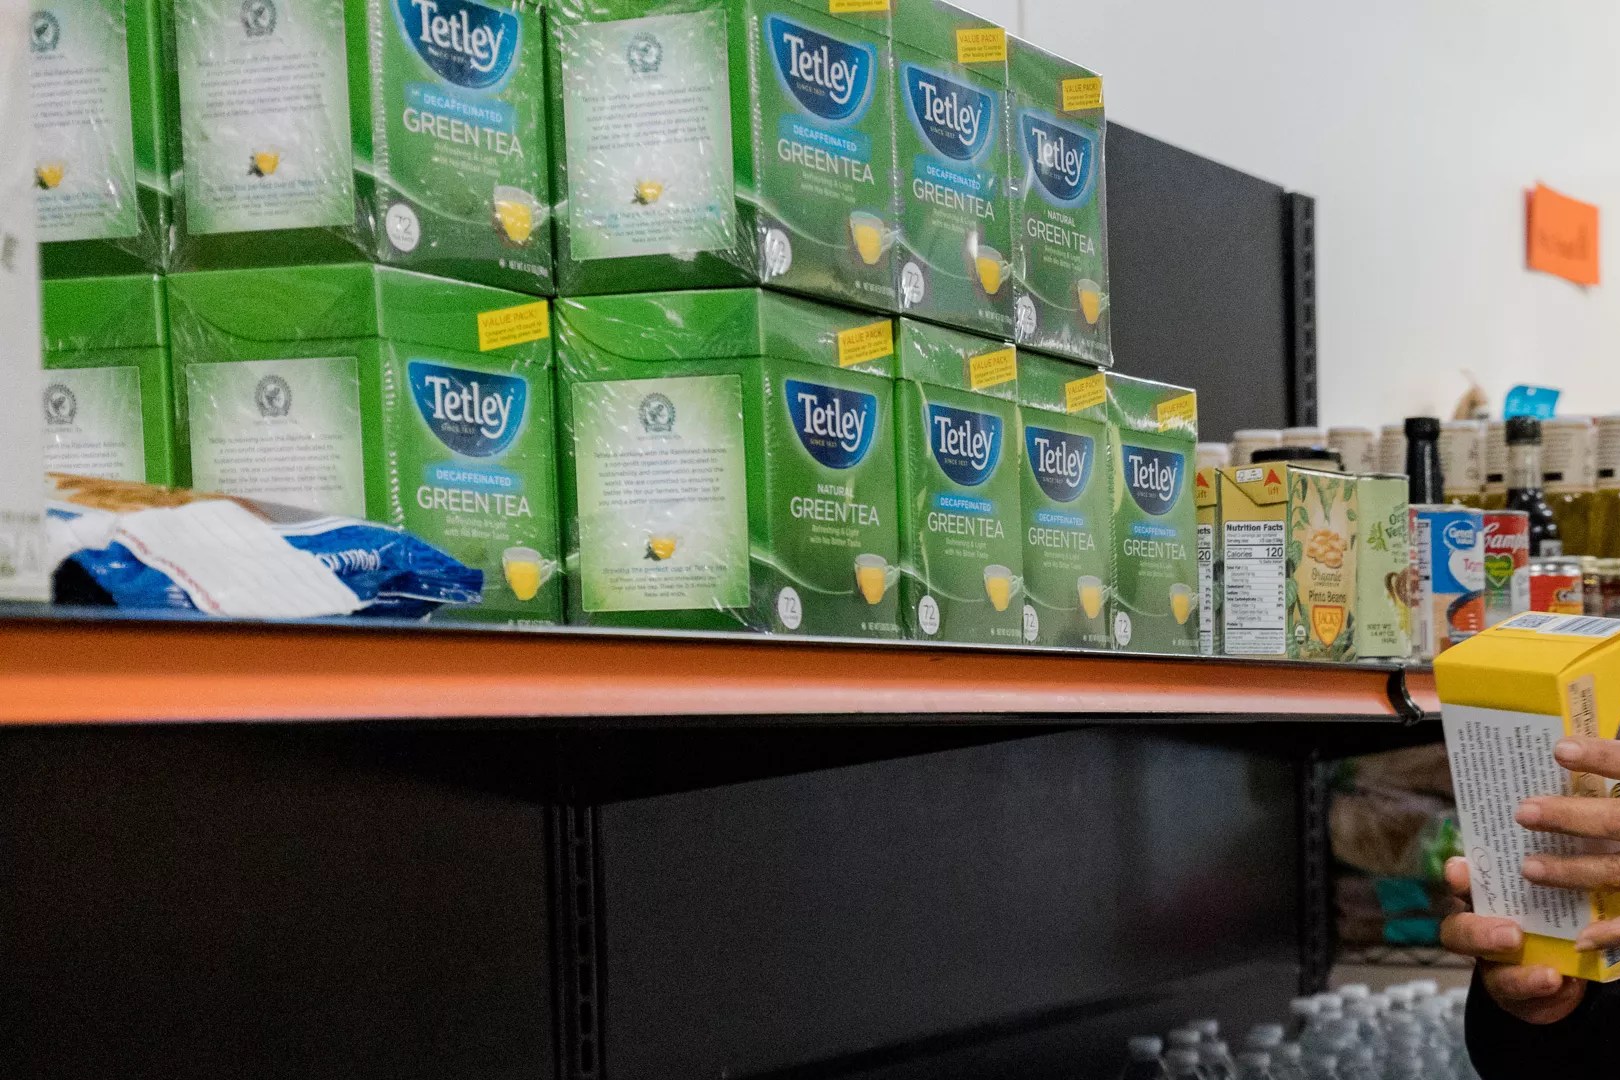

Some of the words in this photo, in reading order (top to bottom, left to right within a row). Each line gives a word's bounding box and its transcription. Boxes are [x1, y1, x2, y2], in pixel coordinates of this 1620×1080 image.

[411, 0, 506, 73] Tetley
[960, 33, 981, 45] VALUE
[783, 32, 860, 105] Tetley
[1064, 84, 1083, 94] VALUE
[422, 94, 503, 123] DECAFFEINATED
[918, 79, 983, 147] Tetley
[402, 107, 481, 148] GREEN
[482, 126, 525, 159] TEA
[792, 124, 858, 152] DECAFFEINATED
[777, 138, 840, 176] GREEN
[840, 156, 876, 186] TEA
[1031, 126, 1086, 187] Tetley
[926, 164, 982, 192] DECAFFEINATED
[911, 177, 967, 214] GREEN
[966, 196, 996, 222] TEA
[1046, 209, 1077, 227] NATURAL
[1026, 216, 1072, 249] GREEN
[1070, 232, 1096, 257] TEA
[483, 316, 512, 329] VALUE
[842, 333, 864, 346] VALUE
[971, 359, 993, 372] VALUE
[1066, 383, 1086, 396] VALUE
[424, 375, 515, 440] Tetley
[797, 392, 868, 453] Tetley
[934, 415, 996, 471] Tetley
[1034, 436, 1089, 488] Tetley
[435, 469, 512, 487] DECAFFEINATED
[1127, 453, 1179, 502] Tetley
[816, 483, 856, 499] NATURAL
[1266, 486, 1280, 498] lift
[416, 486, 490, 514] GREEN
[491, 492, 532, 518] TEA
[789, 495, 848, 524] GREEN
[847, 503, 881, 528] TEA
[939, 496, 993, 513] DECAFFEINATED
[926, 511, 976, 538] GREEN
[977, 517, 1005, 540] TEA
[1038, 513, 1085, 527] DECAFFEINATED
[1226, 523, 1261, 532] Nutrition
[1263, 523, 1284, 532] Facts
[1027, 526, 1072, 549] GREEN
[1071, 532, 1096, 551] TEA
[1133, 524, 1178, 538] DECAFFEINATED
[1122, 538, 1165, 561] GREEN
[1164, 542, 1188, 562] TEA
[1197, 550, 1211, 562] 20
[1226, 550, 1253, 558] Calories
[1265, 547, 1284, 558] 120
[1311, 568, 1342, 583] Organic
[783, 596, 797, 615] 72
[1308, 590, 1326, 603] Pinto
[1327, 591, 1347, 604] Beans
[922, 604, 936, 621] 72
[1023, 612, 1037, 628] 72
[1117, 618, 1130, 635] 72
